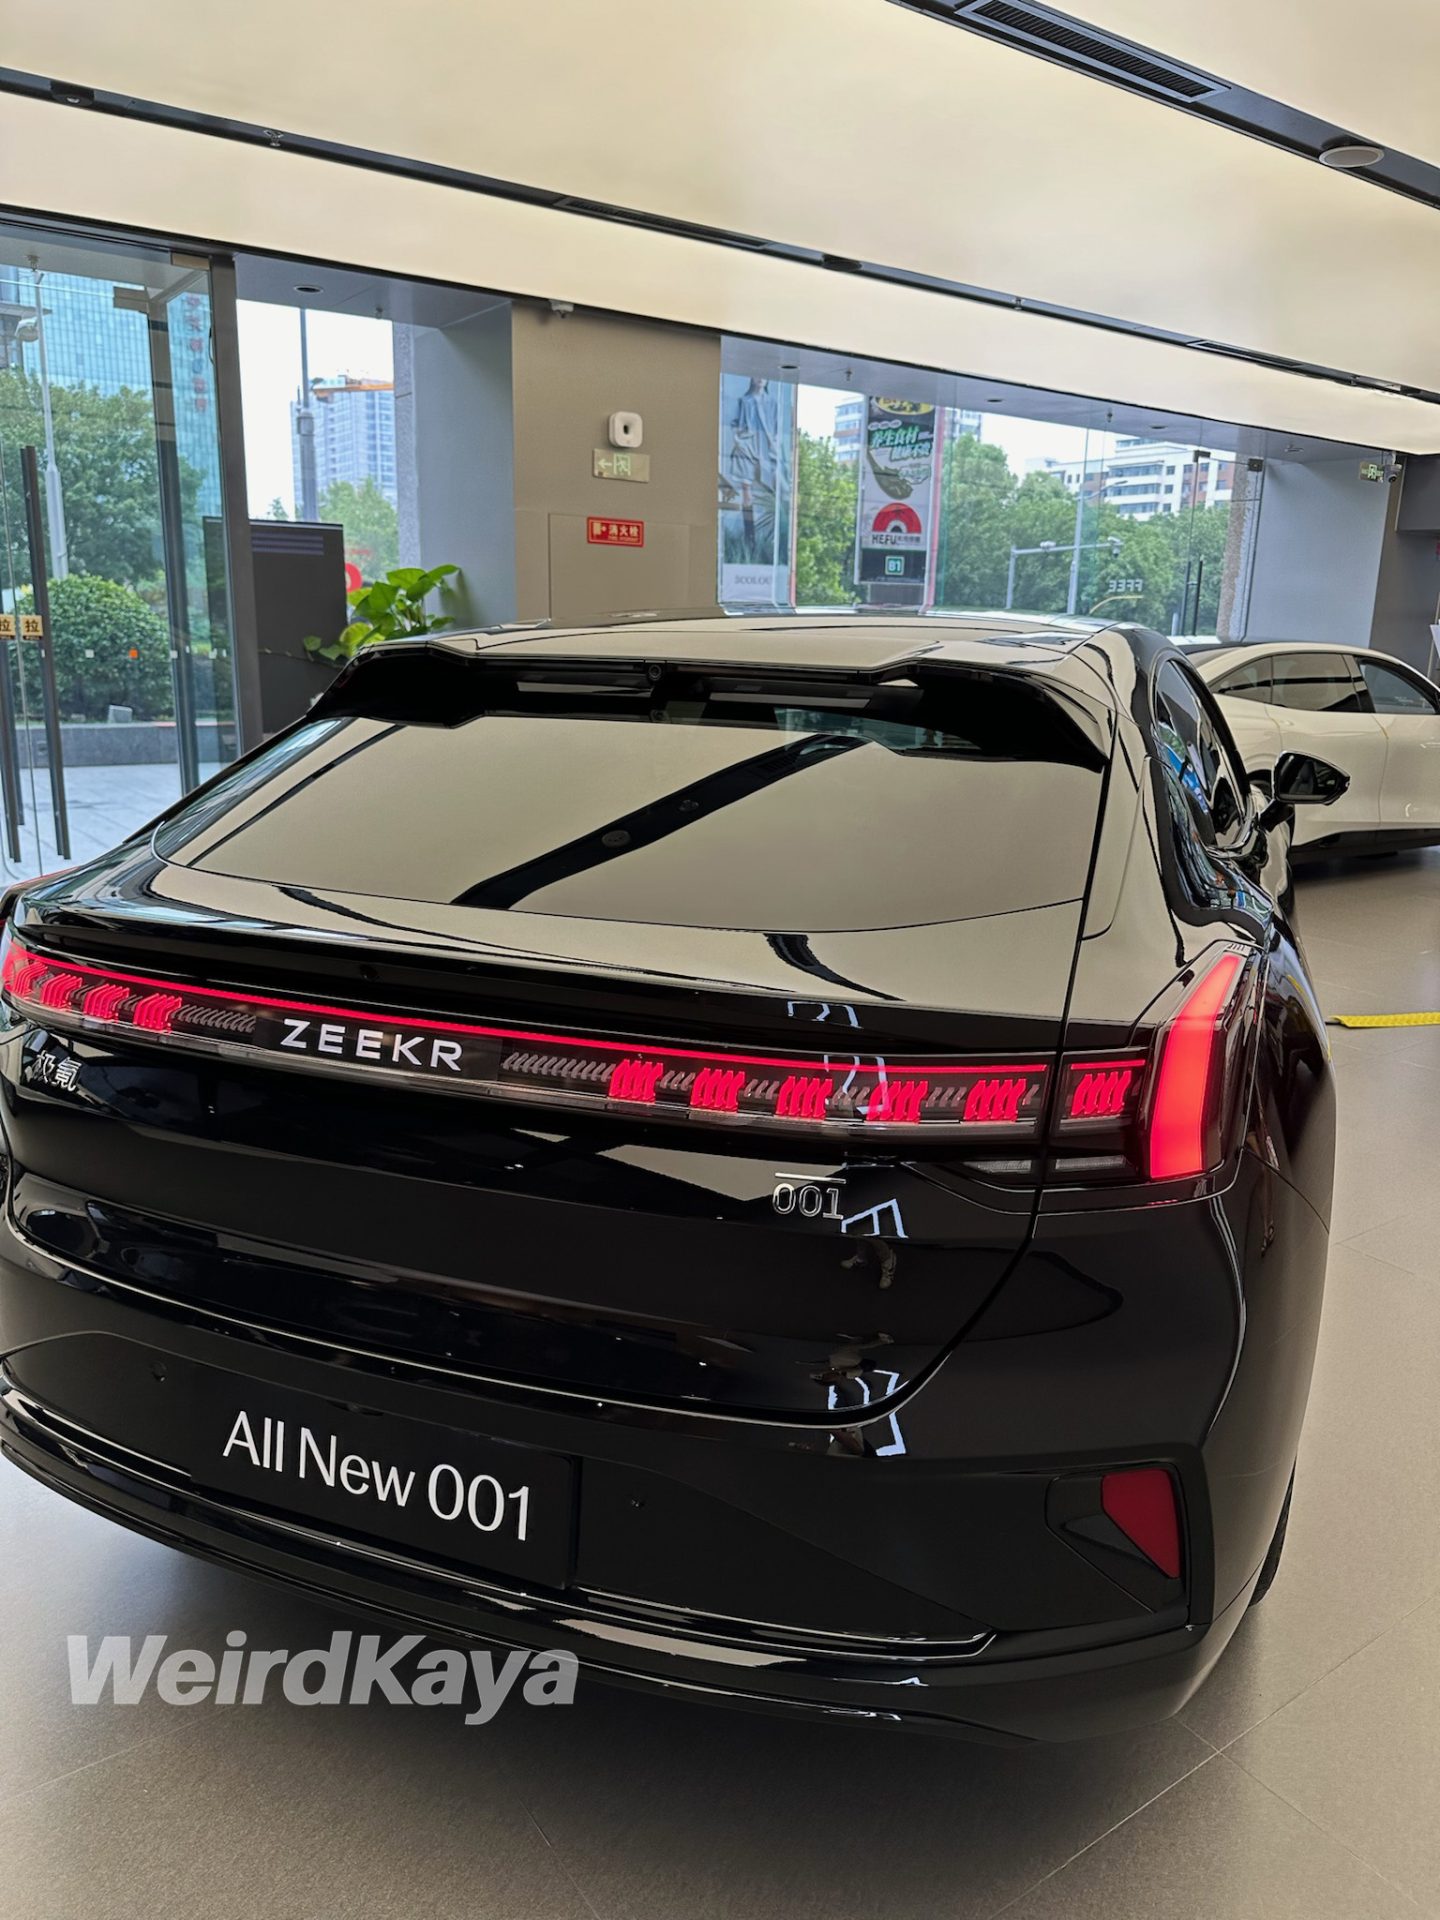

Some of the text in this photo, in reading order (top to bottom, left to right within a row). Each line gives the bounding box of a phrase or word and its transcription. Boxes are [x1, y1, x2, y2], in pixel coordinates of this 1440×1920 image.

[872, 534, 897, 545] HEFU
[25, 619, 40, 632] 拉
[280, 1018, 463, 1072] ZEEKR
[32, 1050, 82, 1091] 极氪
[772, 1182, 844, 1220] 001
[222, 1410, 529, 1542] All New 001
